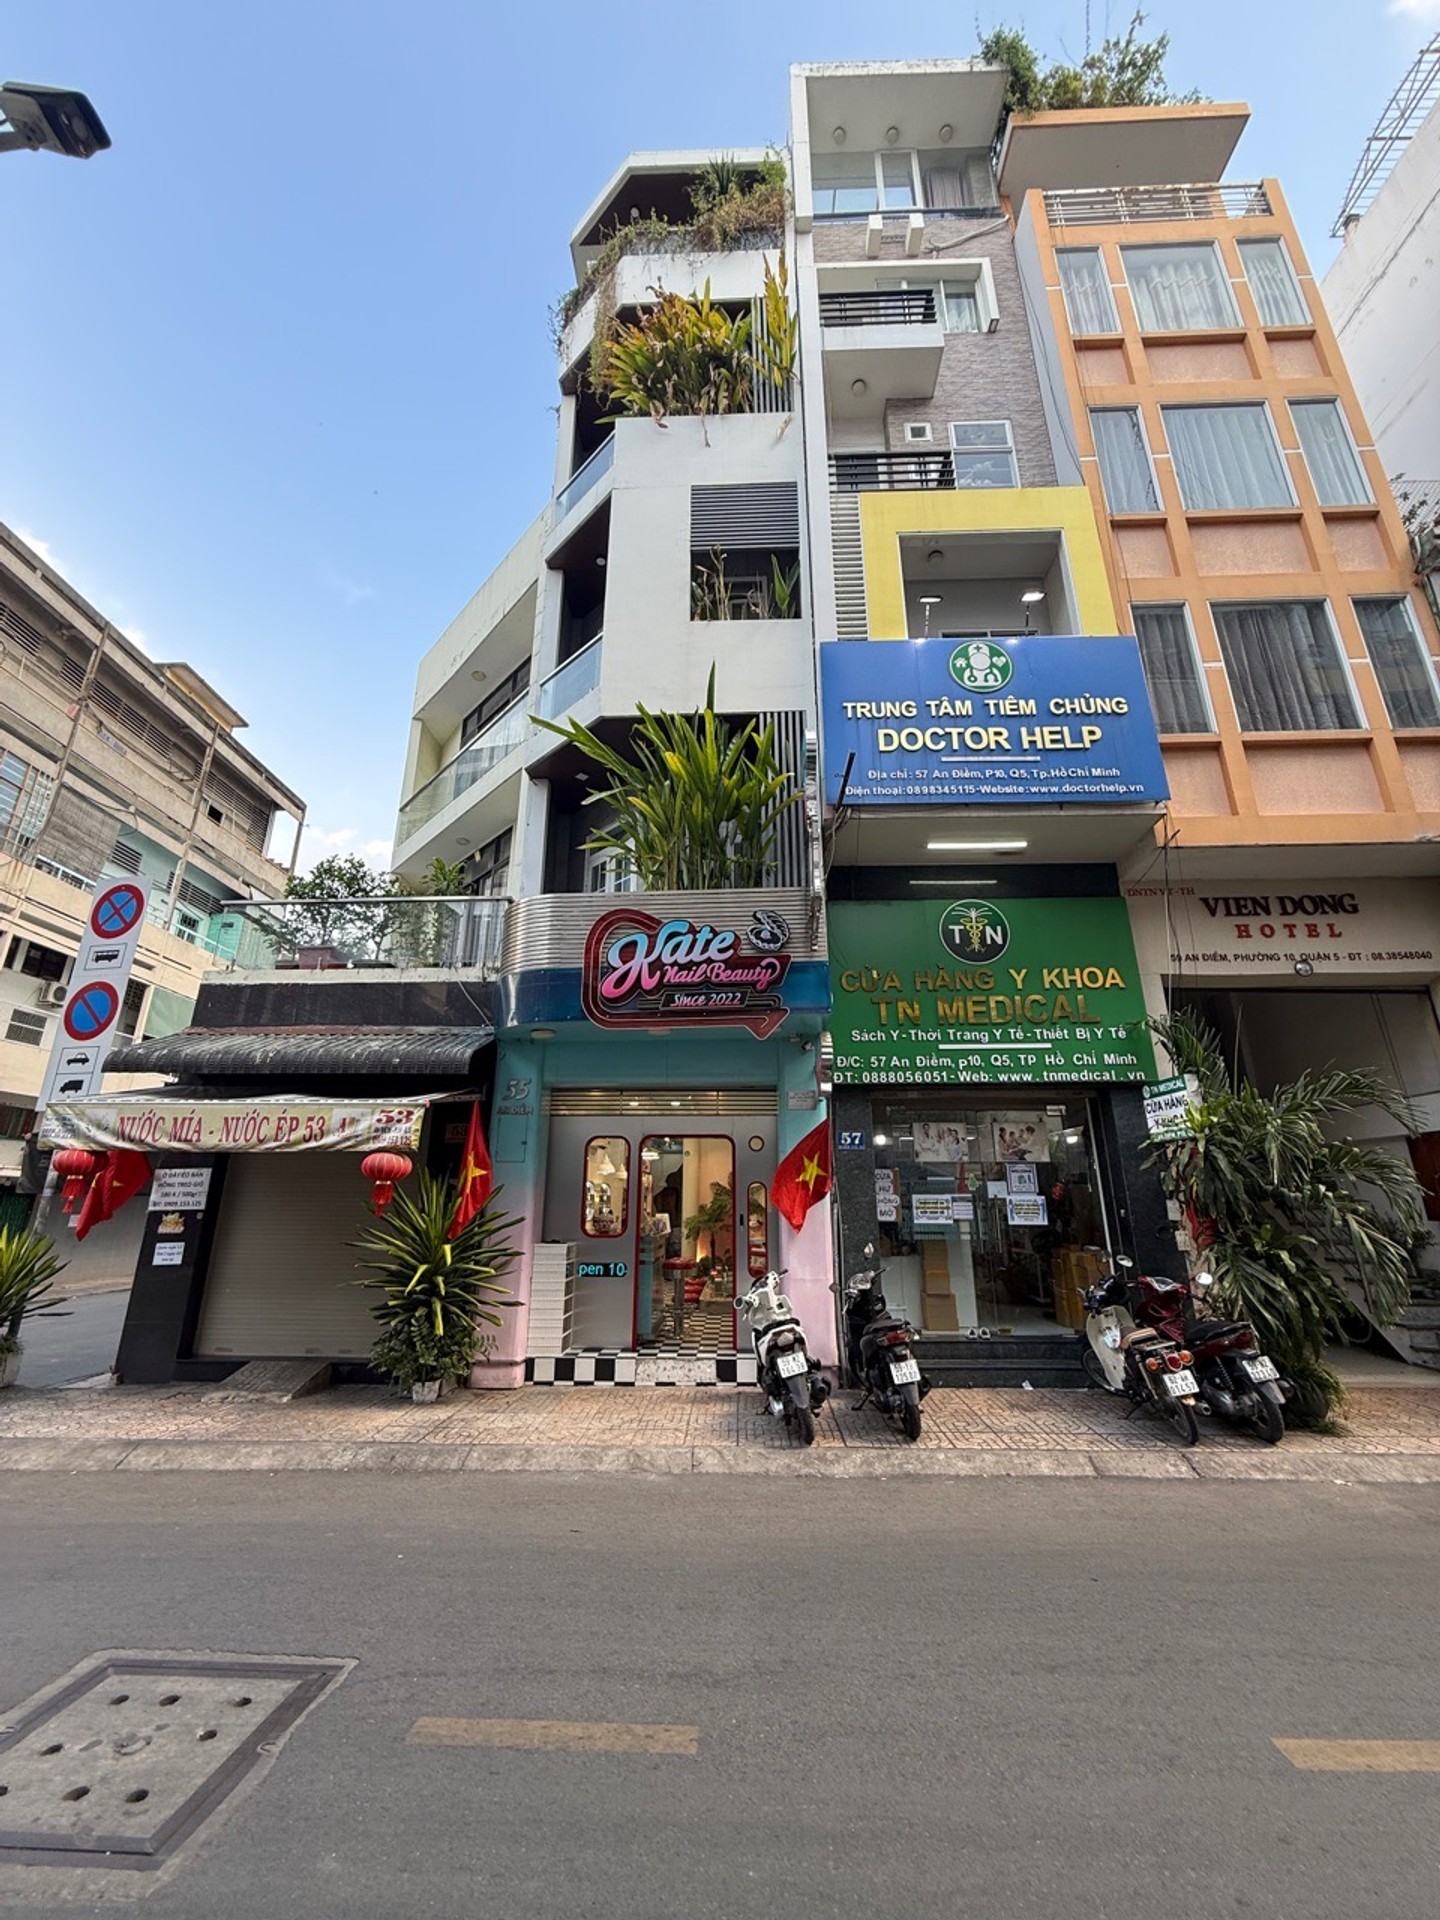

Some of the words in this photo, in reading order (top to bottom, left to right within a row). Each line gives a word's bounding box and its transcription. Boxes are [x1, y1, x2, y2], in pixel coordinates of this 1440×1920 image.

[843, 701, 917, 718] TRUNG
[926, 697, 973, 717] TÂM
[984, 695, 1037, 715] TIÊM
[1050, 694, 1129, 714] CHỦNG
[878, 726, 1011, 752] DOCTOR
[1020, 725, 1103, 750] HELP
[868, 770, 887, 780] Địa
[916, 770, 928, 779] 57
[933, 770, 948, 779] An
[1092, 768, 1121, 777] Minh
[1200, 896, 1272, 917] VIEN
[1276, 893, 1360, 916] DONG
[602, 920, 735, 998] Kate
[1185, 954, 1200, 962] AN
[1299, 953, 1331, 963] QUẬN
[1334, 953, 1340, 961] 5
[664, 964, 706, 983] Nail
[707, 957, 780, 991] Beauty
[841, 964, 902, 992] CỬA
[914, 963, 995, 990] HÀNG
[1008, 968, 1028, 989] Y
[1042, 967, 1126, 989] KHOA
[670, 993, 706, 1008] Since
[709, 992, 741, 1006] 2022
[872, 996, 921, 1025] TN
[937, 994, 1101, 1025] MEDICAL
[851, 1029, 886, 1041] Sách
[947, 1028, 989, 1042] Trang
[993, 1029, 1002, 1039] Y
[1076, 1027, 1090, 1042] Bị
[1093, 1027, 1103, 1039] Y
[1108, 1024, 1126, 1039] Tế
[870, 1055, 885, 1067] 57
[890, 1056, 910, 1067] An
[990, 1054, 1014, 1067] Q5,
[1018, 1054, 1036, 1065] TP
[1104, 1053, 1137, 1064] Minh
[116, 1109, 166, 1142] NƯỚC
[168, 1109, 203, 1142] MÍA
[218, 1109, 270, 1143] NƯỚC
[273, 1109, 300, 1143] ÉP
[303, 1115, 326, 1143] 53
[376, 1109, 415, 1124] 53
[841, 1132, 862, 1145] 57
[579, 1264, 604, 1277] pen
